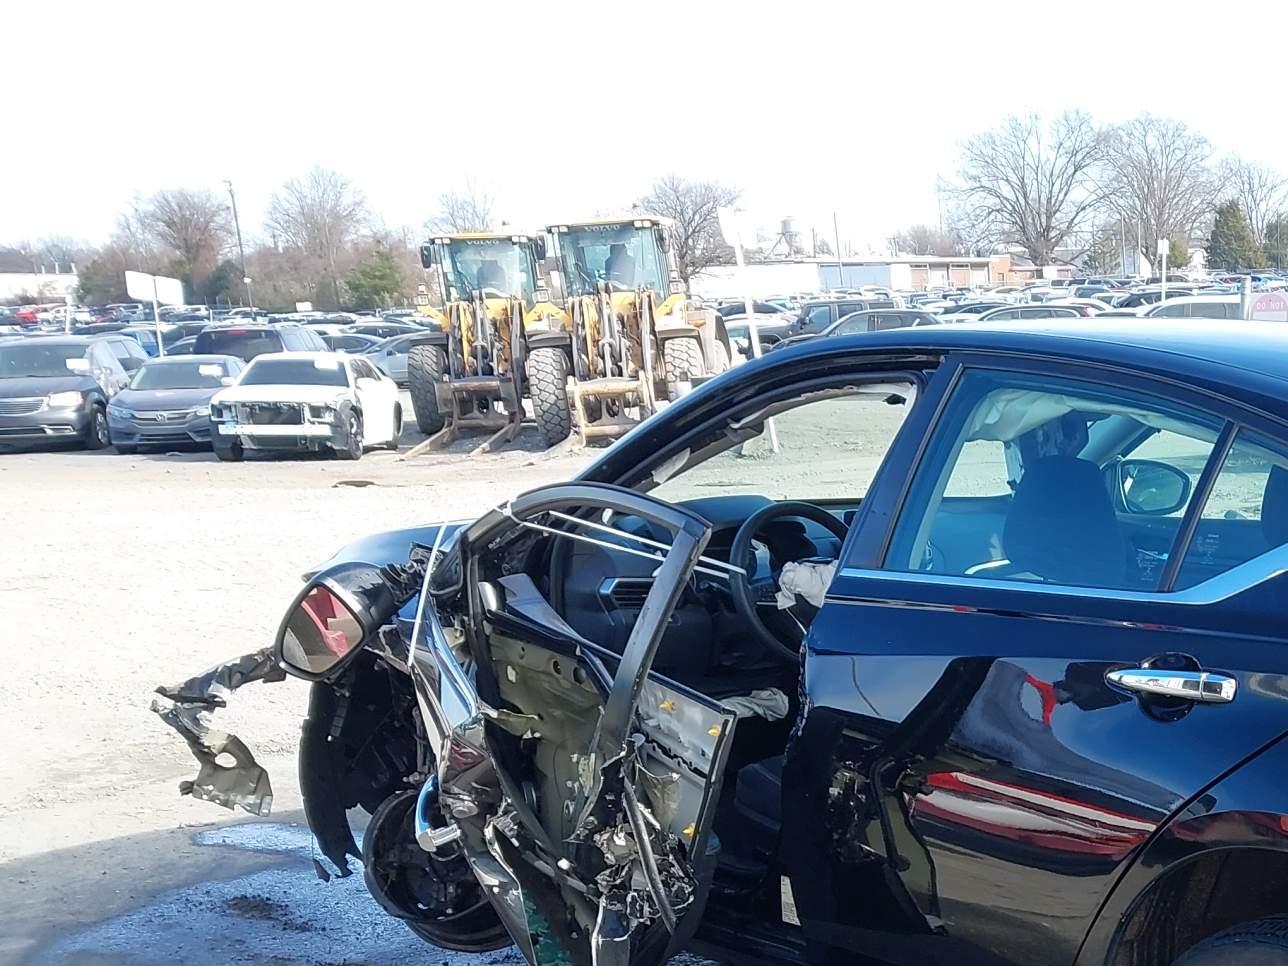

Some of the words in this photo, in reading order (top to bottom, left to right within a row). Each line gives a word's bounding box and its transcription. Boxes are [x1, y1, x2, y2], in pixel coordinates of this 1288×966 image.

[583, 224, 621, 233] VOLVO
[1256, 302, 1266, 310] DO
[1270, 301, 1285, 310] NOT
